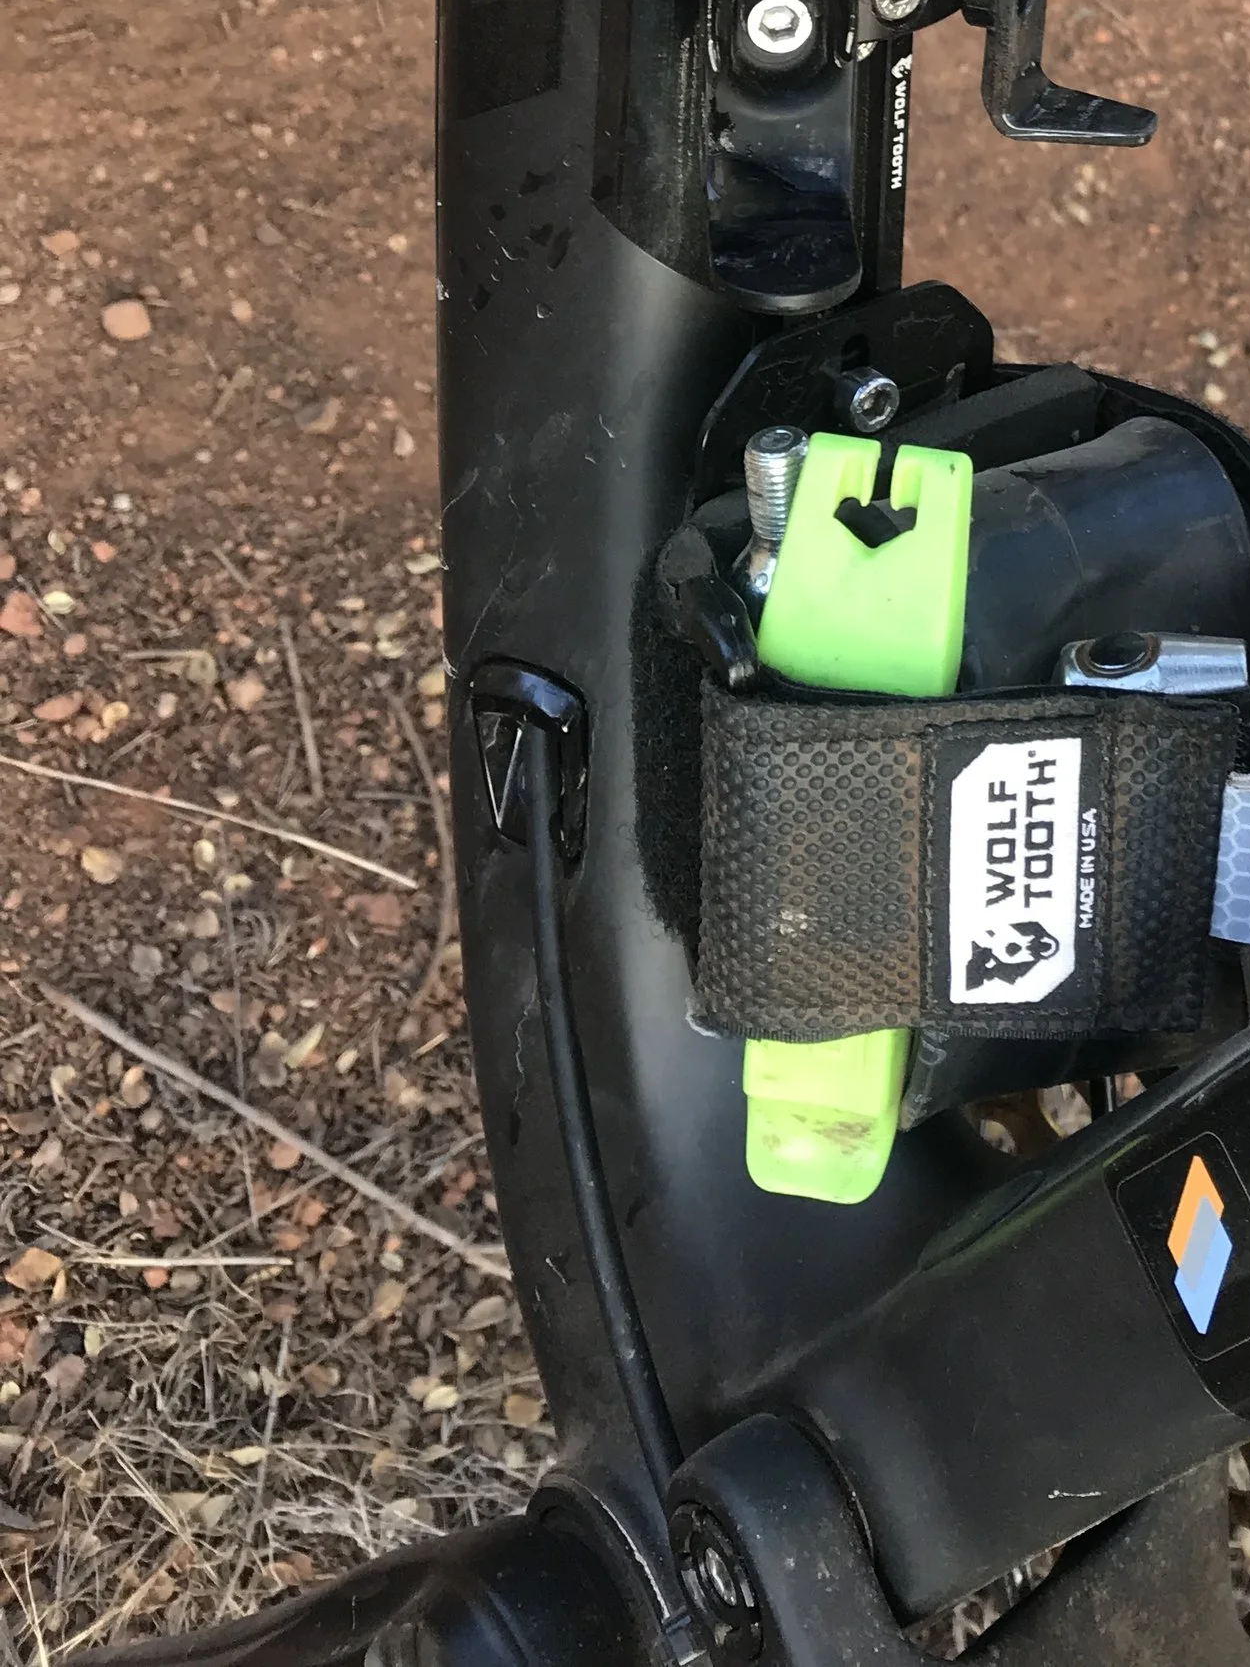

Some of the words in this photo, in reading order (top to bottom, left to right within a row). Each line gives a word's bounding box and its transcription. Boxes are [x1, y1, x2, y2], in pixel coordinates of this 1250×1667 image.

[893, 81, 907, 128] WOLF
[890, 132, 905, 189] TOOTH
[986, 781, 1017, 908] WOLF
[1024, 759, 1057, 908] TOOTH
[1081, 808, 1097, 851] USA
[1080, 855, 1095, 872] IN
[1079, 875, 1094, 928] MADE
